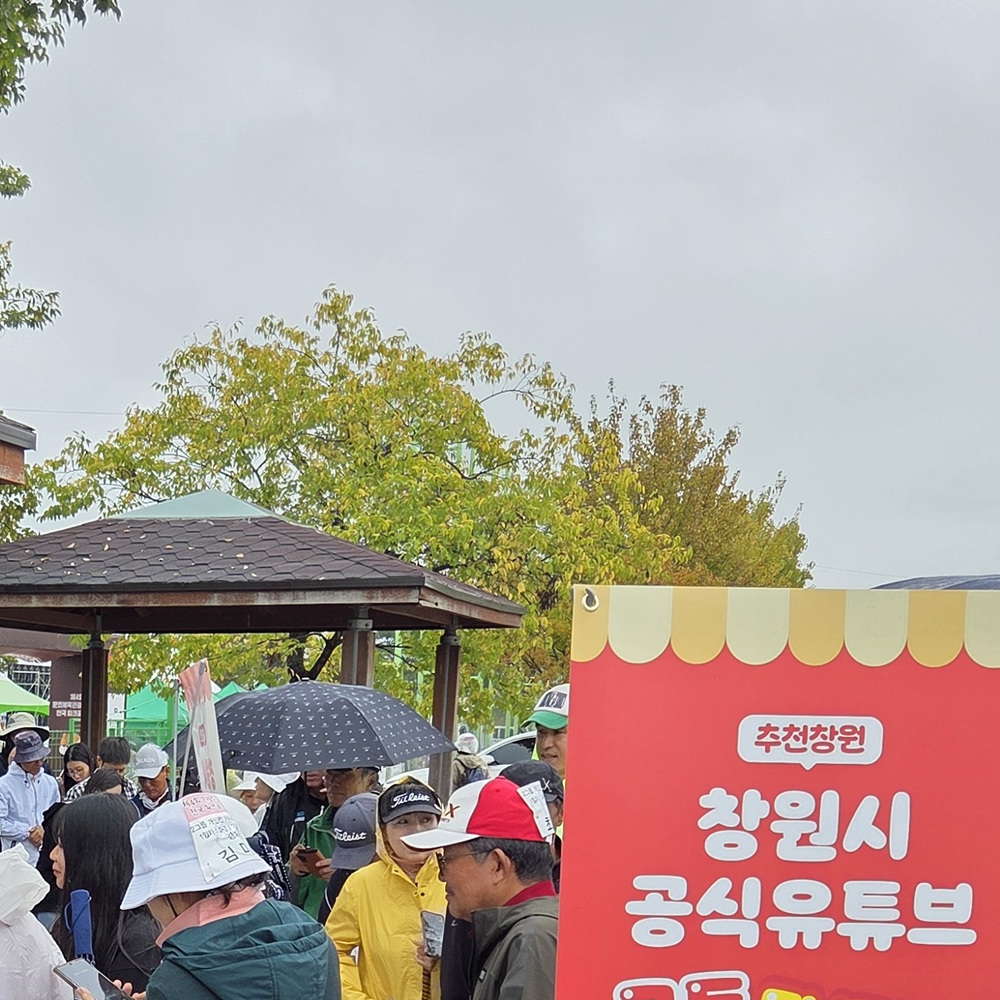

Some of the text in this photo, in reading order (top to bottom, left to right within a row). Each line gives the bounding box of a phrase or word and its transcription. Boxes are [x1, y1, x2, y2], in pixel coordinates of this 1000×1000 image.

[754, 722, 867, 754] 추천창원
[698, 787, 911, 862] 창원시
[625, 875, 977, 951] 공식유튜브
